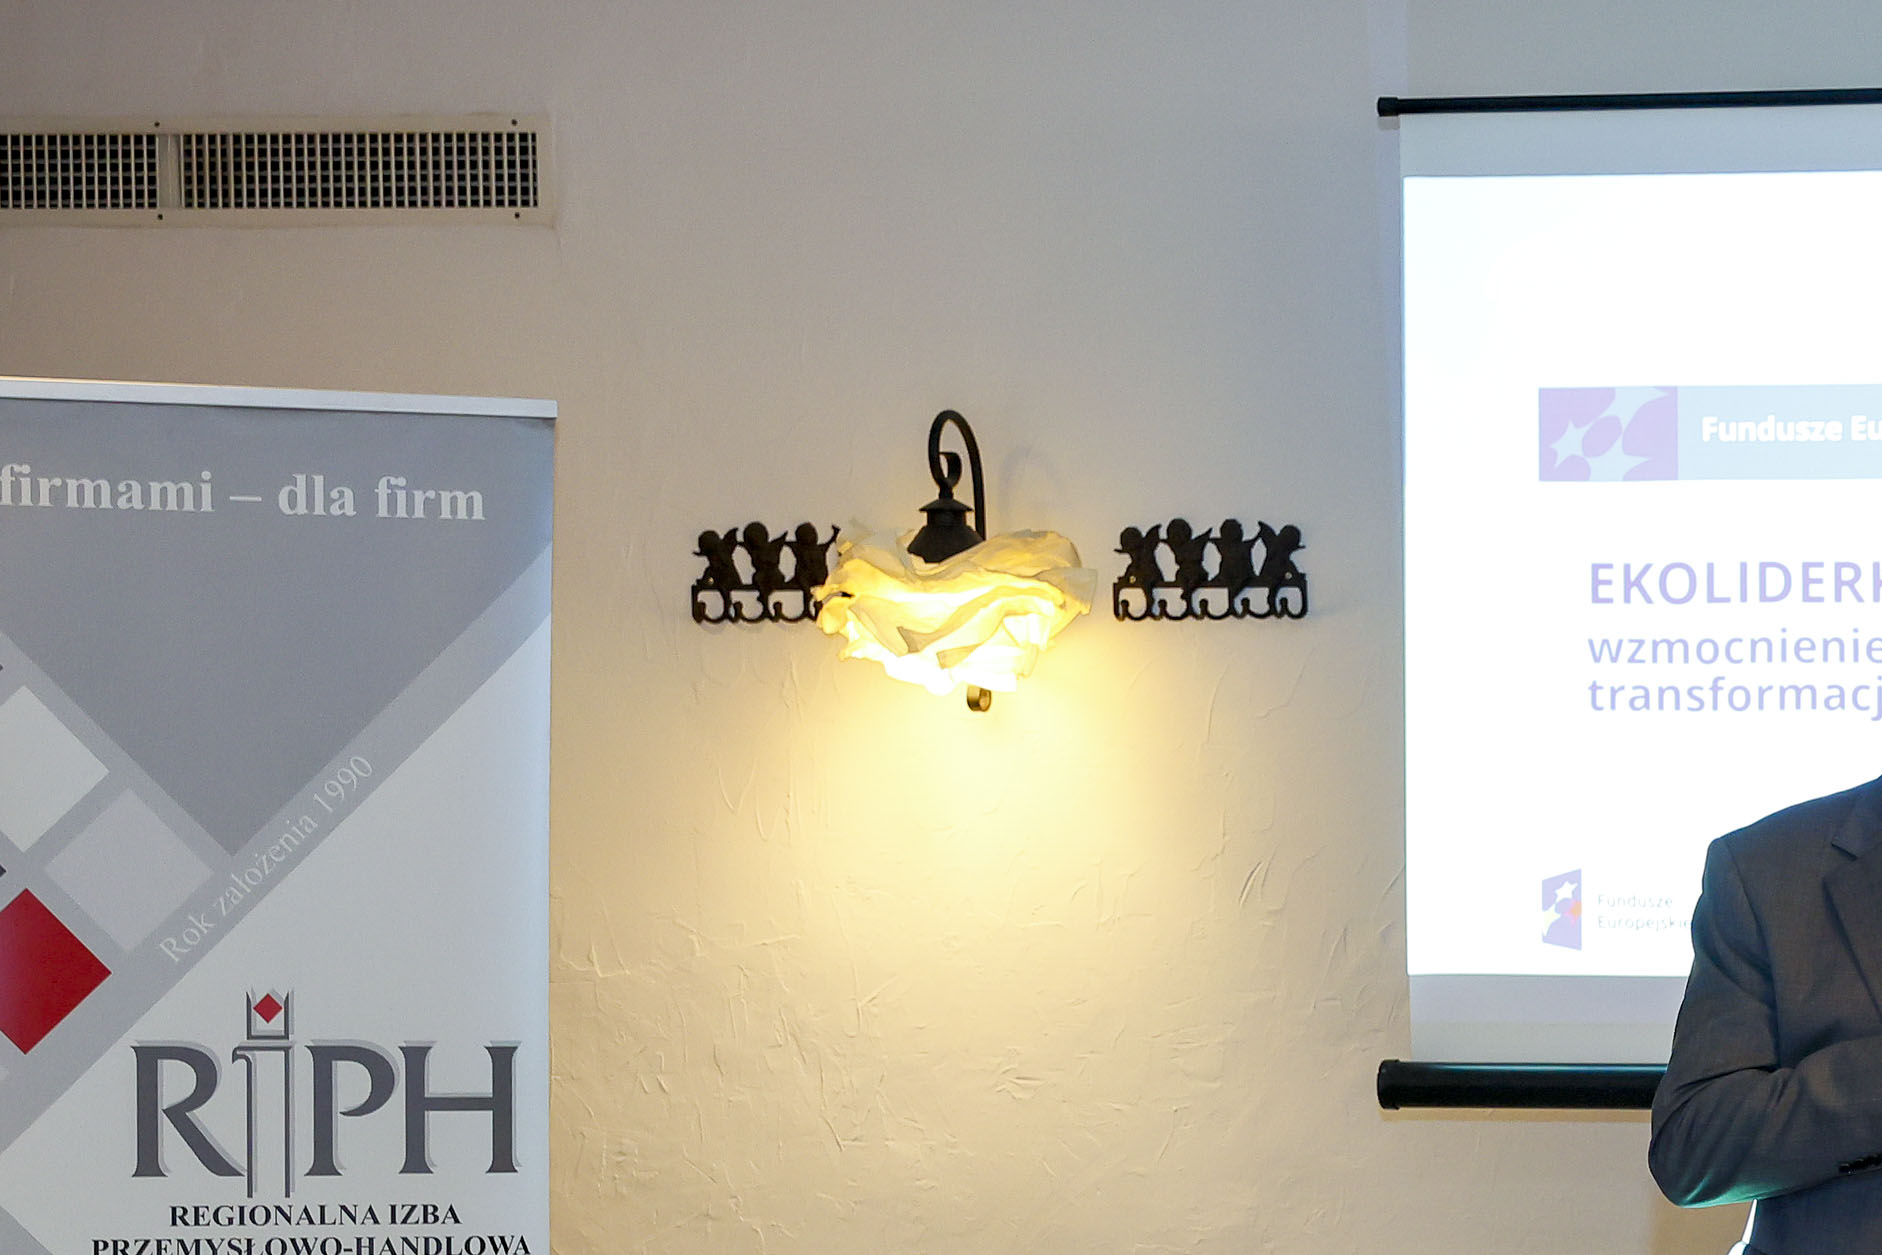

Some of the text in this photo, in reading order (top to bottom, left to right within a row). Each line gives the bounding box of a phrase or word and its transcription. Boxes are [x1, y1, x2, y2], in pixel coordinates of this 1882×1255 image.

[1701, 414, 1843, 443] Fundusze
[0, 463, 215, 512] firmami
[278, 474, 356, 517] dla
[375, 476, 485, 520] firm
[158, 755, 373, 963] Rok założenia 1990
[1598, 894, 1673, 908] Fundusze
[130, 1038, 523, 1199] RIPH
[168, 1203, 463, 1229] REGIONALNA IZBA
